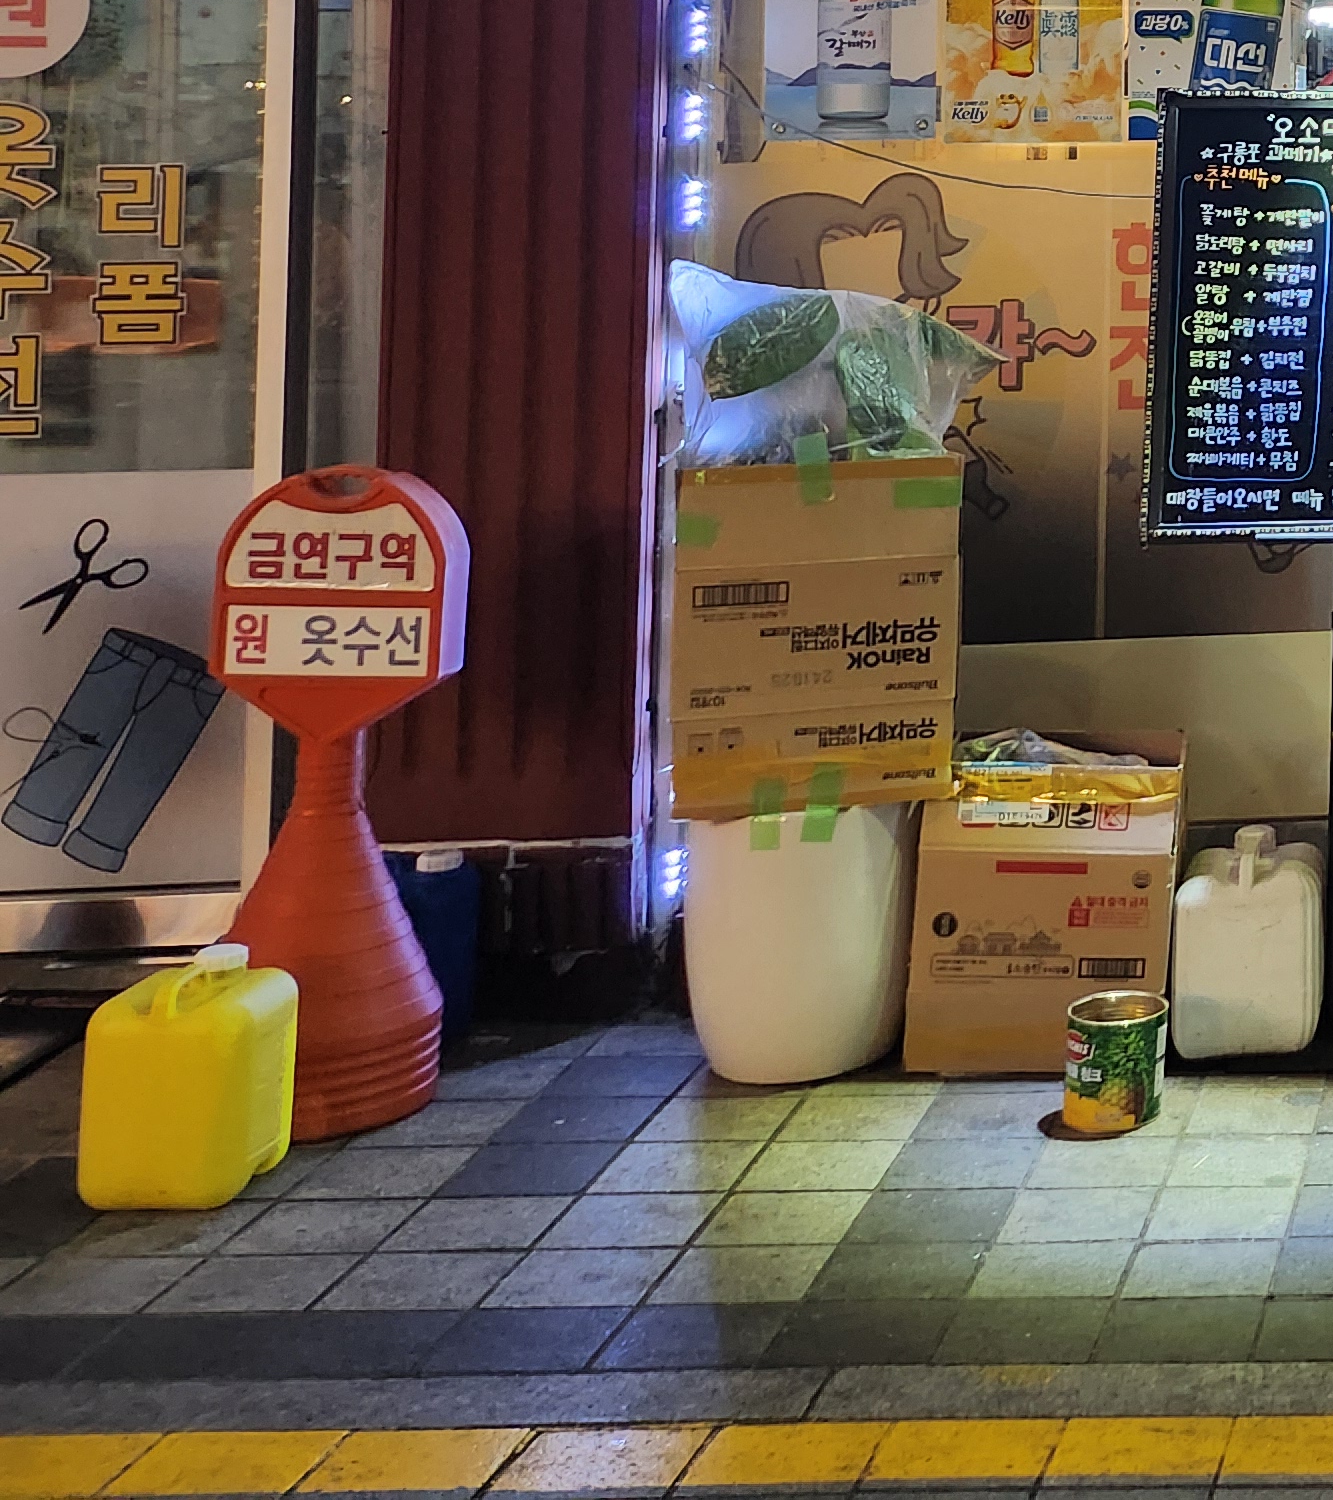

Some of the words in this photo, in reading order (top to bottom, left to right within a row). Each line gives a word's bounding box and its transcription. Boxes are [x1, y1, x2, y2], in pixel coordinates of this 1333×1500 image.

[994, 9, 1032, 31] Kelly
[824, 38, 877, 57] 갈매기
[1203, 36, 1267, 74] 대선
[951, 107, 989, 124] Kelly
[1216, 141, 1262, 166] 구룡포
[1264, 144, 1321, 163] 과메기
[1199, 203, 1251, 227] 꽃게탕
[92, 164, 187, 346] 리폼
[1193, 260, 1241, 278] 고갈비
[1260, 425, 1293, 449] 황도
[247, 531, 417, 581] 금연구역
[232, 613, 270, 665] 원
[300, 614, 423, 667] 옷수선
[840, 616, 941, 649] 유막제거
[846, 647, 931, 670] RainOK
[859, 718, 939, 745] 유막제거
